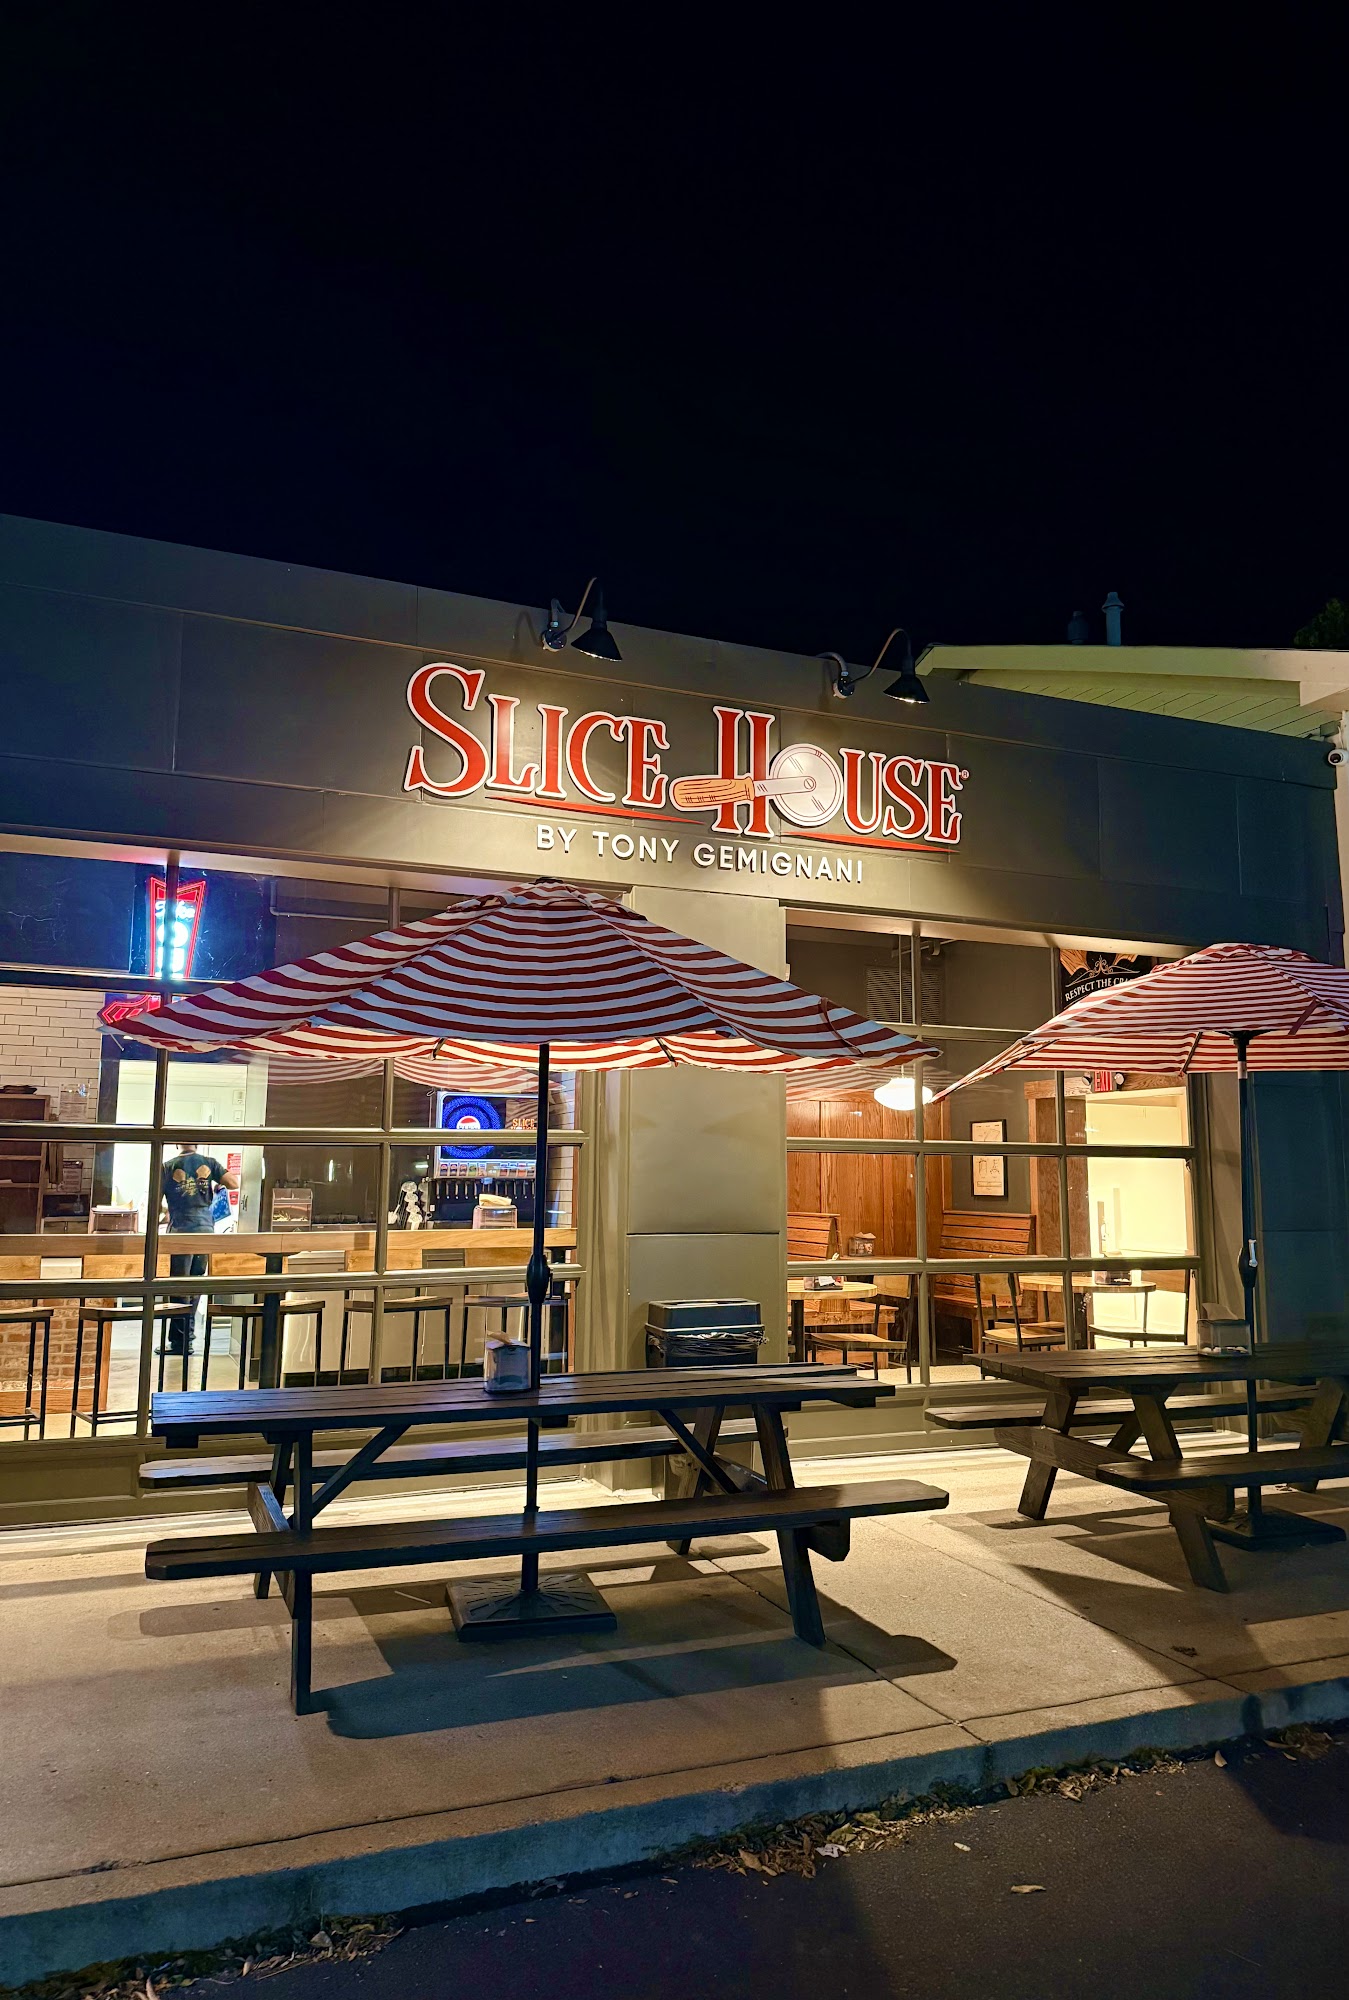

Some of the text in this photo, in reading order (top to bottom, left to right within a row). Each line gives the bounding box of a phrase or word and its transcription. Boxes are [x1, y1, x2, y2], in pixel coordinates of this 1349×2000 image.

[404, 662, 670, 808] SLICE
[536, 824, 863, 883] BY TONY GEMIGNANI
[1065, 981, 1095, 1001] RESPECT
[1096, 978, 1112, 989] THE
[1094, 1070, 1112, 1091] EXIT
